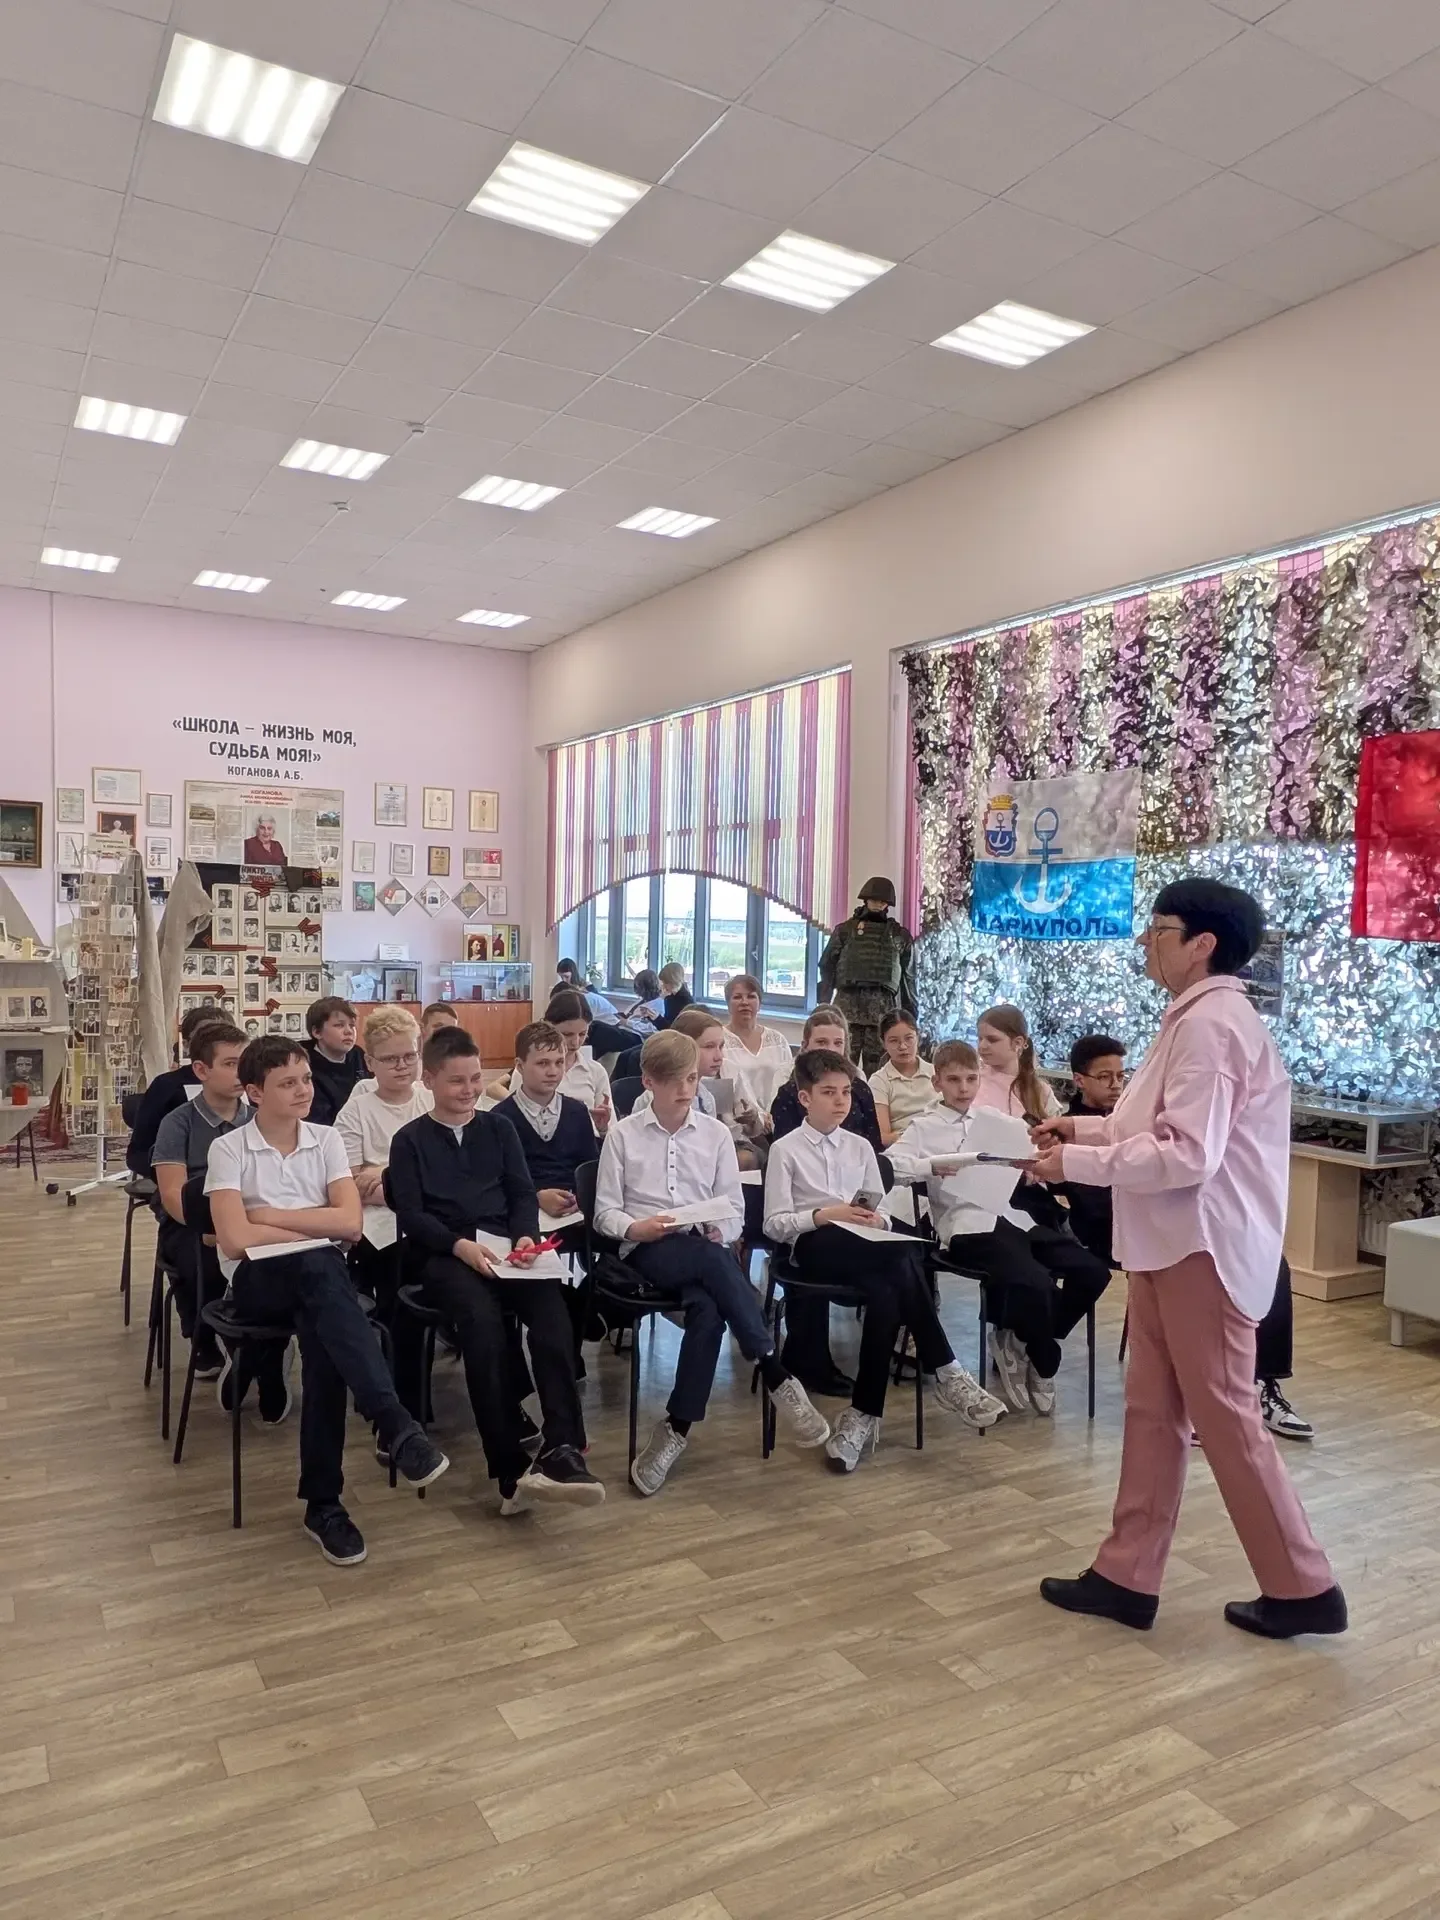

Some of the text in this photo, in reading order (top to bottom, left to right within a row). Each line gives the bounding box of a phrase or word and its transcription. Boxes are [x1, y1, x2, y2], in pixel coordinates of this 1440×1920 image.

[172, 716, 240, 736] «ШКОЛА
[262, 723, 314, 742] ЖИЗНЬ
[322, 729, 357, 748] МОЯ,
[209, 741, 322, 763] СУДЬБА МОЯ!»
[227, 765, 304, 780] КОГАНОВА А.Б.
